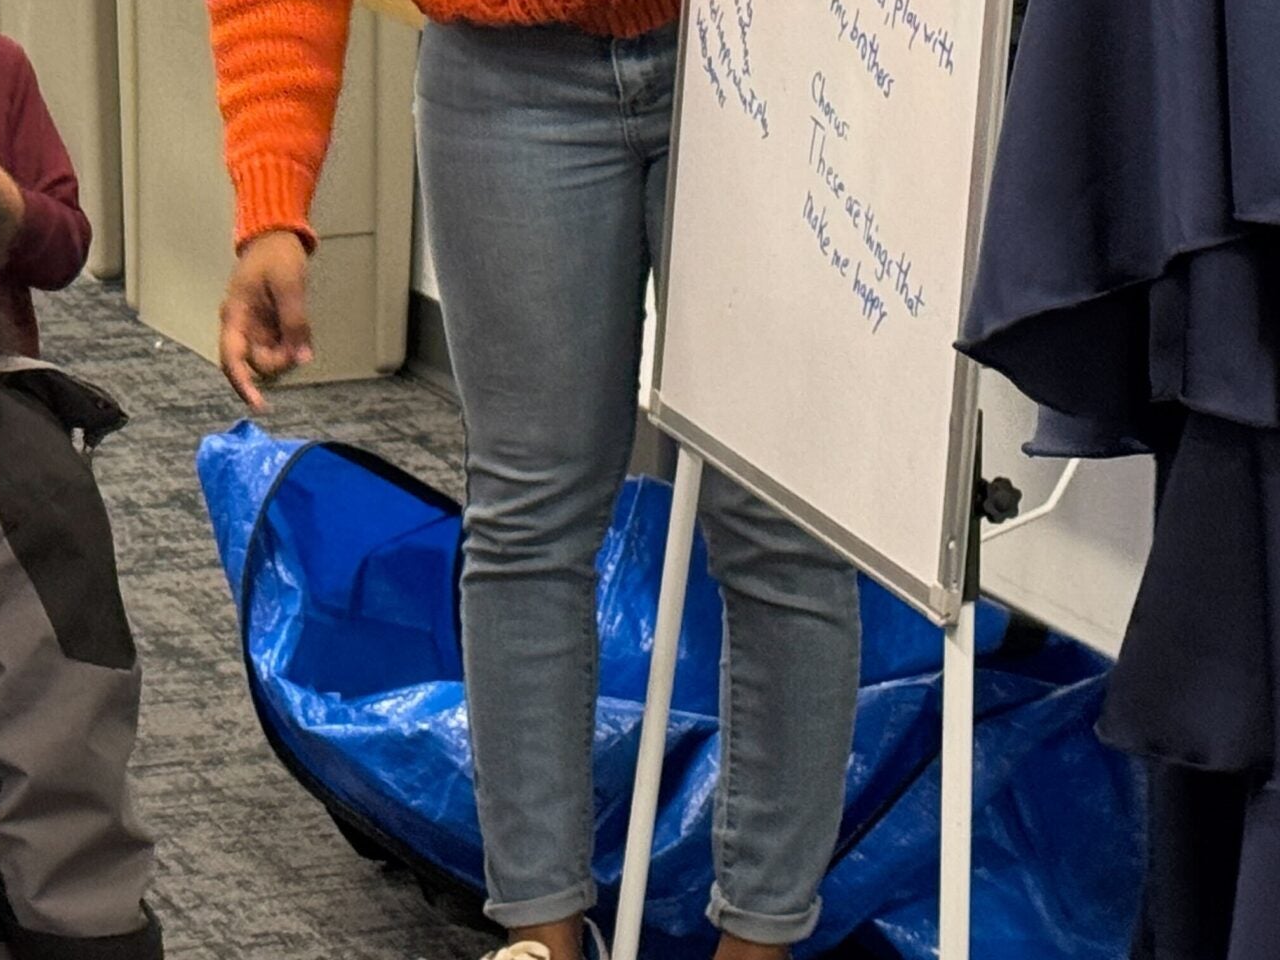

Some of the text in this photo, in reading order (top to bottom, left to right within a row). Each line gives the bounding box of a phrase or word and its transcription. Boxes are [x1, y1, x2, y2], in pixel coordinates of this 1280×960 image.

[850, 9, 895, 99] brothers
[923, 22, 954, 76] with
[809, 115, 925, 318] These are things that
[830, 248, 850, 278] me
[852, 261, 888, 335] happy
